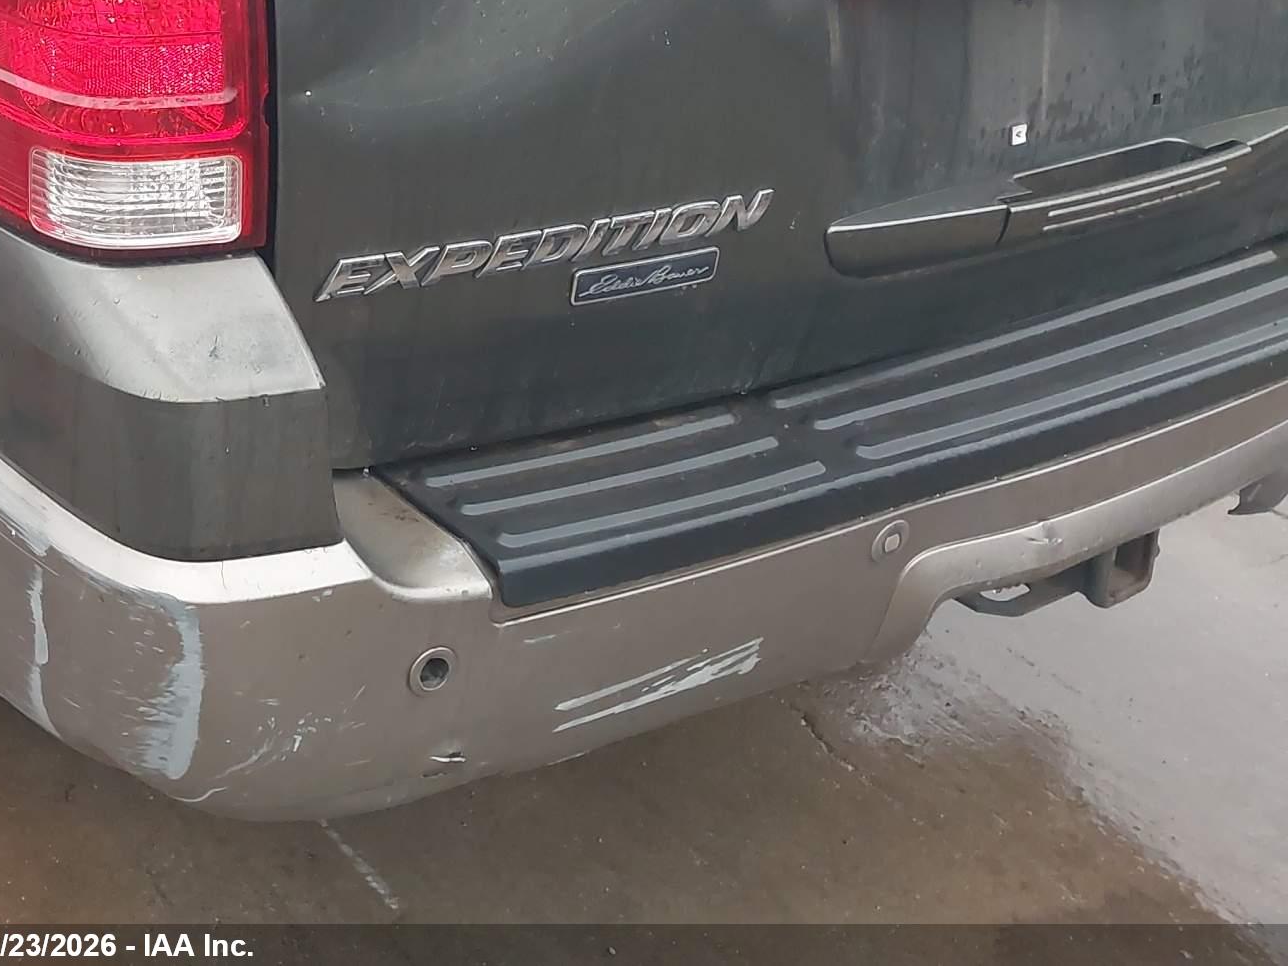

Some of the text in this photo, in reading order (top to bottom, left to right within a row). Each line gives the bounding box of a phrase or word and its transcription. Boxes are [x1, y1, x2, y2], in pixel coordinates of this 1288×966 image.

[315, 188, 775, 302] EXPEDITION
[578, 264, 710, 298] Eddie Bauer
